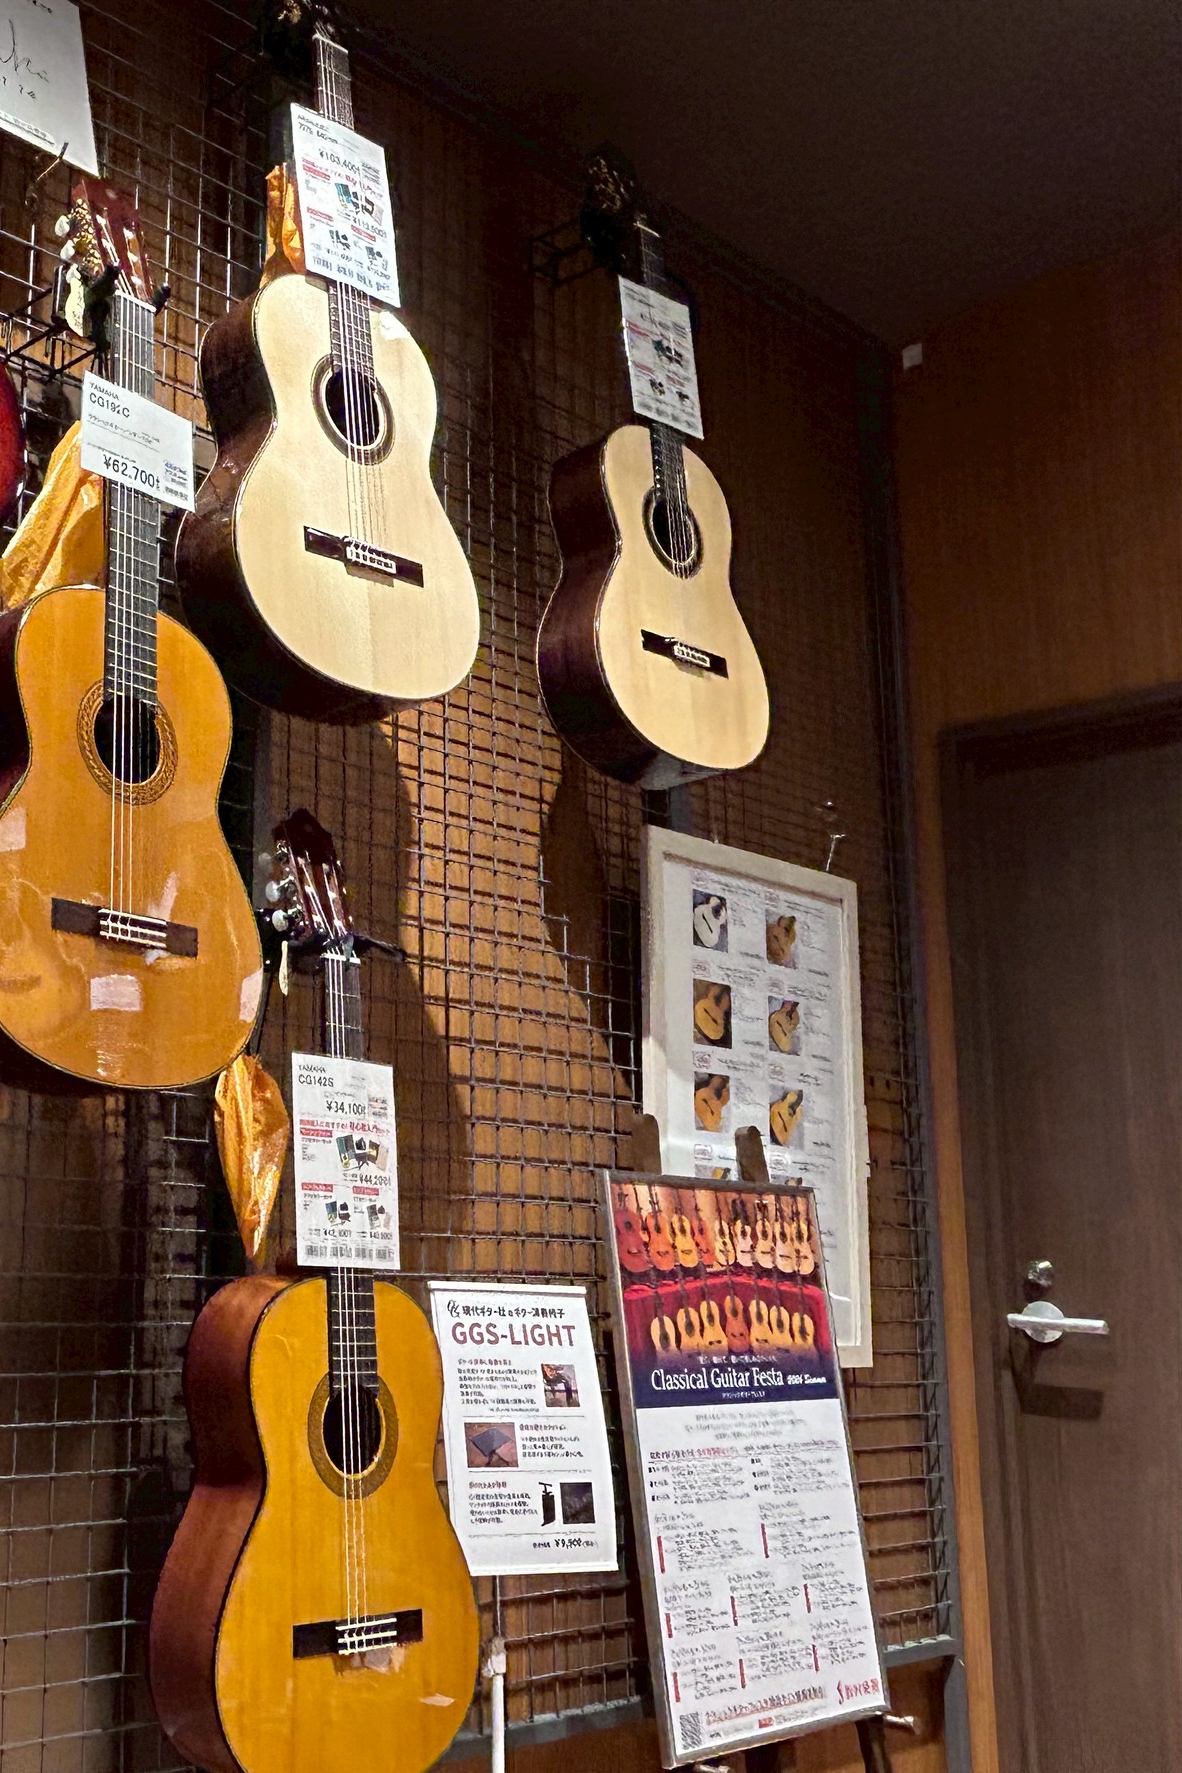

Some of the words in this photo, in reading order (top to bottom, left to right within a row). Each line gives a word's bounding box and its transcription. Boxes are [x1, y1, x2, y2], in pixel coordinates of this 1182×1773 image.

[103, 453, 155, 488] ¥62,700
[326, 1100, 362, 1115] ¥34,100
[451, 1322, 575, 1346] GGS-LIGHT
[651, 1368, 708, 1390] Classical
[710, 1367, 750, 1388] Guitar
[753, 1367, 784, 1387] Festa
